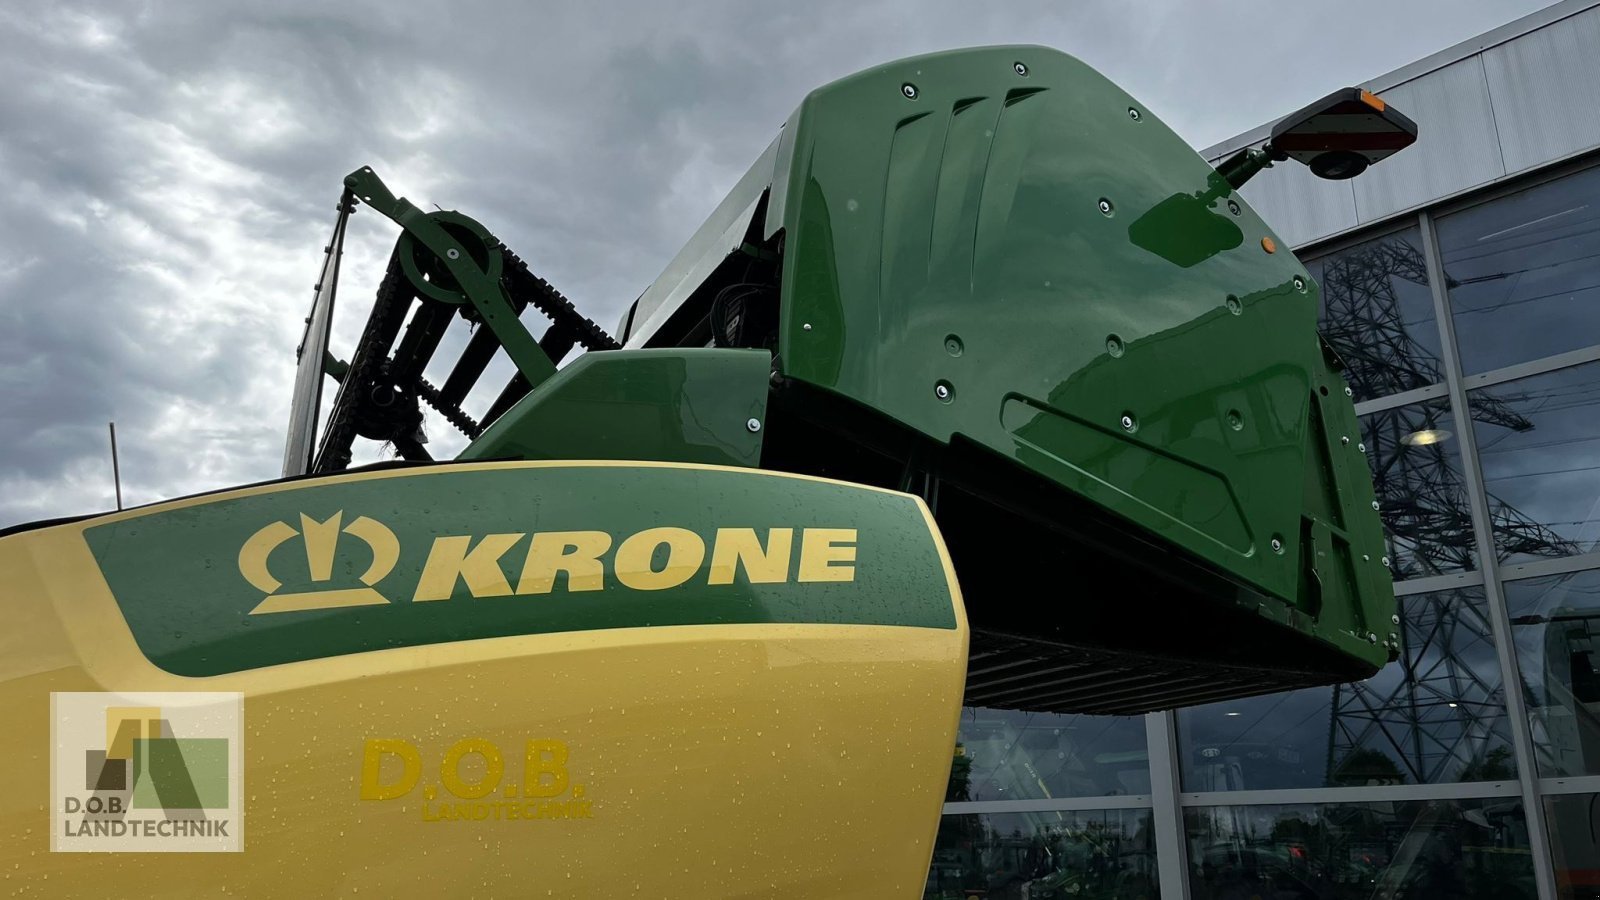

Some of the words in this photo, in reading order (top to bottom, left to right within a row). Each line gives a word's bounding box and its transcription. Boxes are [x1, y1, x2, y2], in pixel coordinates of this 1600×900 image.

[411, 526, 858, 602] KRONE
[359, 738, 586, 800] D.O.B.
[422, 801, 593, 822] LANDTECHNIK
